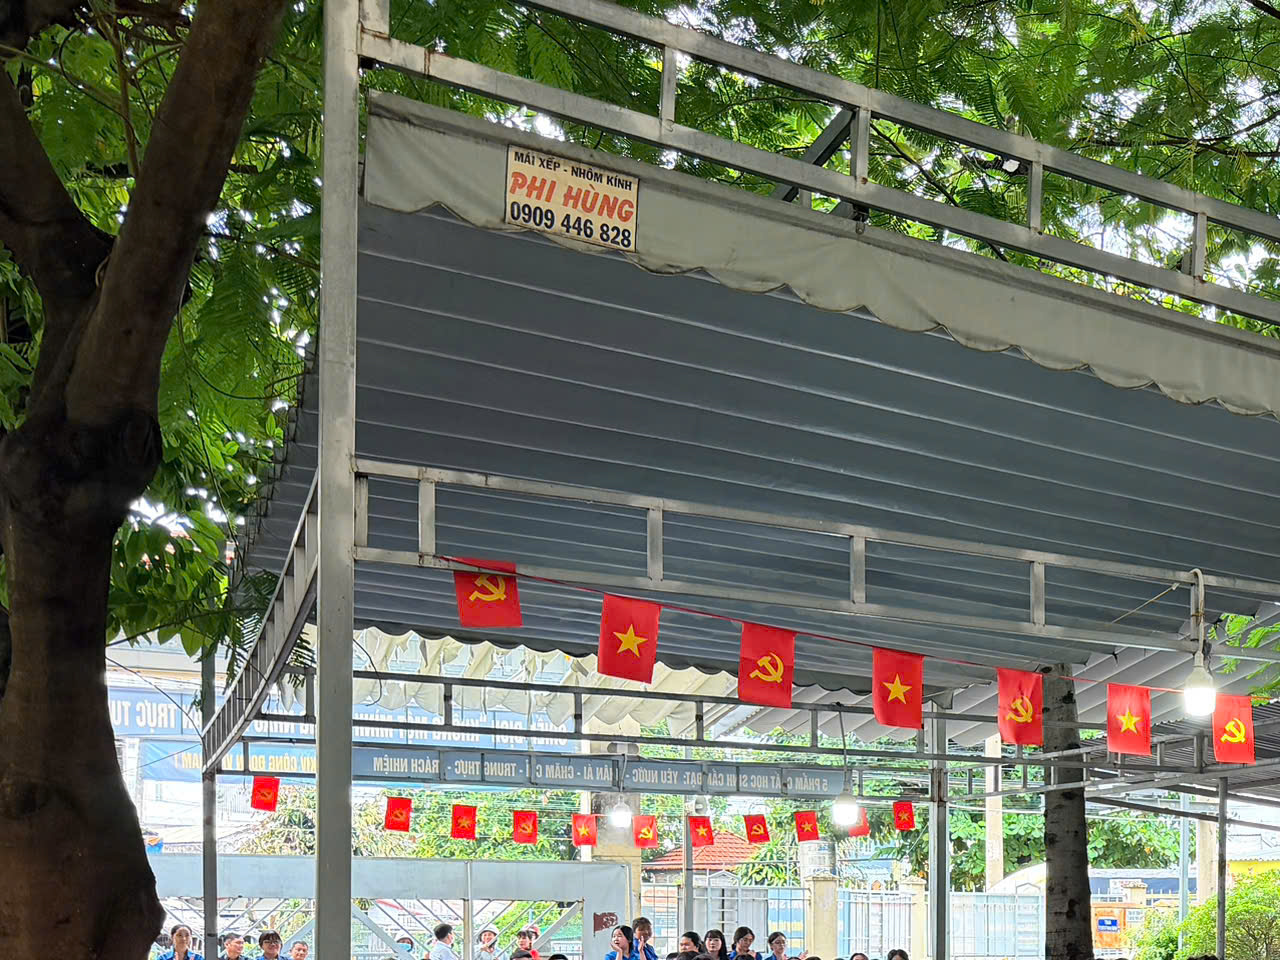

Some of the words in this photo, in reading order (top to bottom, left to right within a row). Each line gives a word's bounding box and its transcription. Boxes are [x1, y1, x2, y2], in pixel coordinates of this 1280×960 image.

[514, 151, 535, 165] MÁI
[538, 156, 560, 172] XẾP
[571, 165, 603, 184] NHÔM
[606, 174, 632, 191] KÍNH
[509, 171, 557, 203] PHI
[562, 183, 635, 223] HÙNG
[510, 201, 555, 230] 0909
[561, 213, 594, 239] 446
[599, 223, 632, 249] 828
